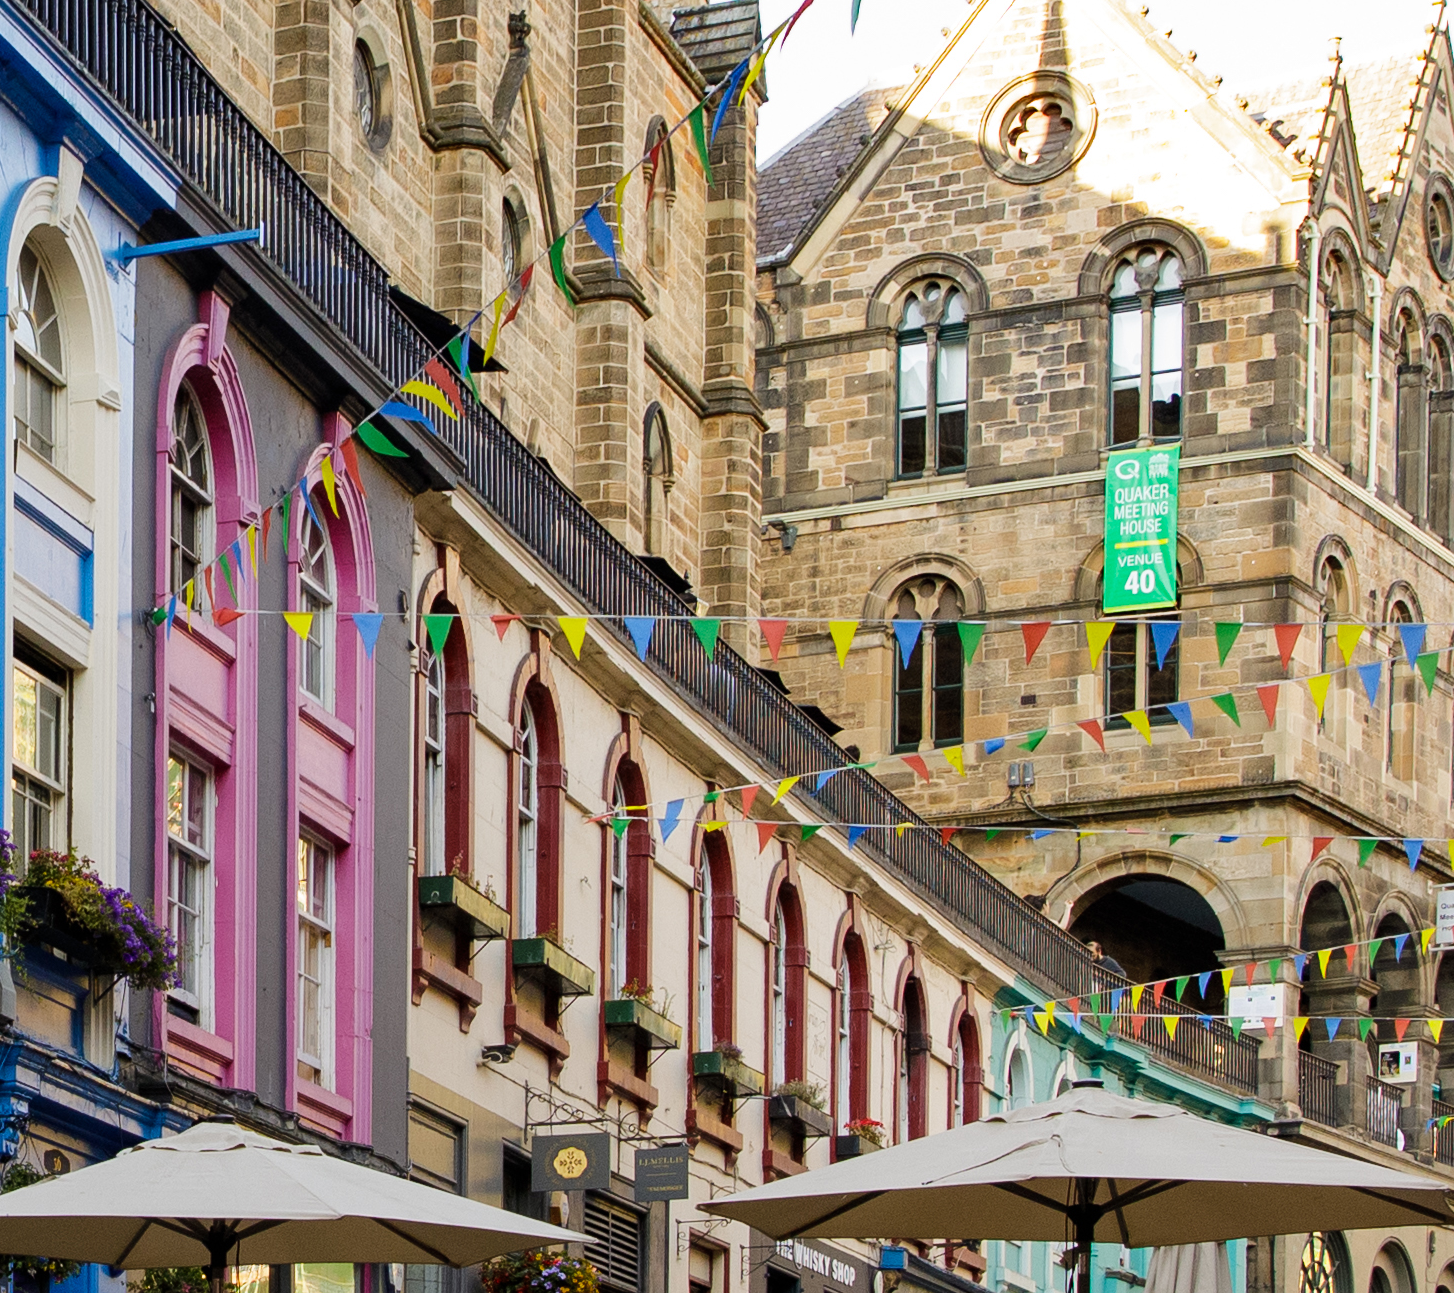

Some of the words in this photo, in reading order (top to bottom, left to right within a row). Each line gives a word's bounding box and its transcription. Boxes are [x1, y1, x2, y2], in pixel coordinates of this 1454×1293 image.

[1114, 483, 1169, 504] QUAKER
[1114, 501, 1169, 520] MEETING
[1120, 518, 1162, 536] HOUSE
[1117, 552, 1163, 568] VENUE
[1124, 569, 1155, 595] 40
[794, 1240, 831, 1277] WHISKY
[831, 1258, 856, 1287] SHOP
